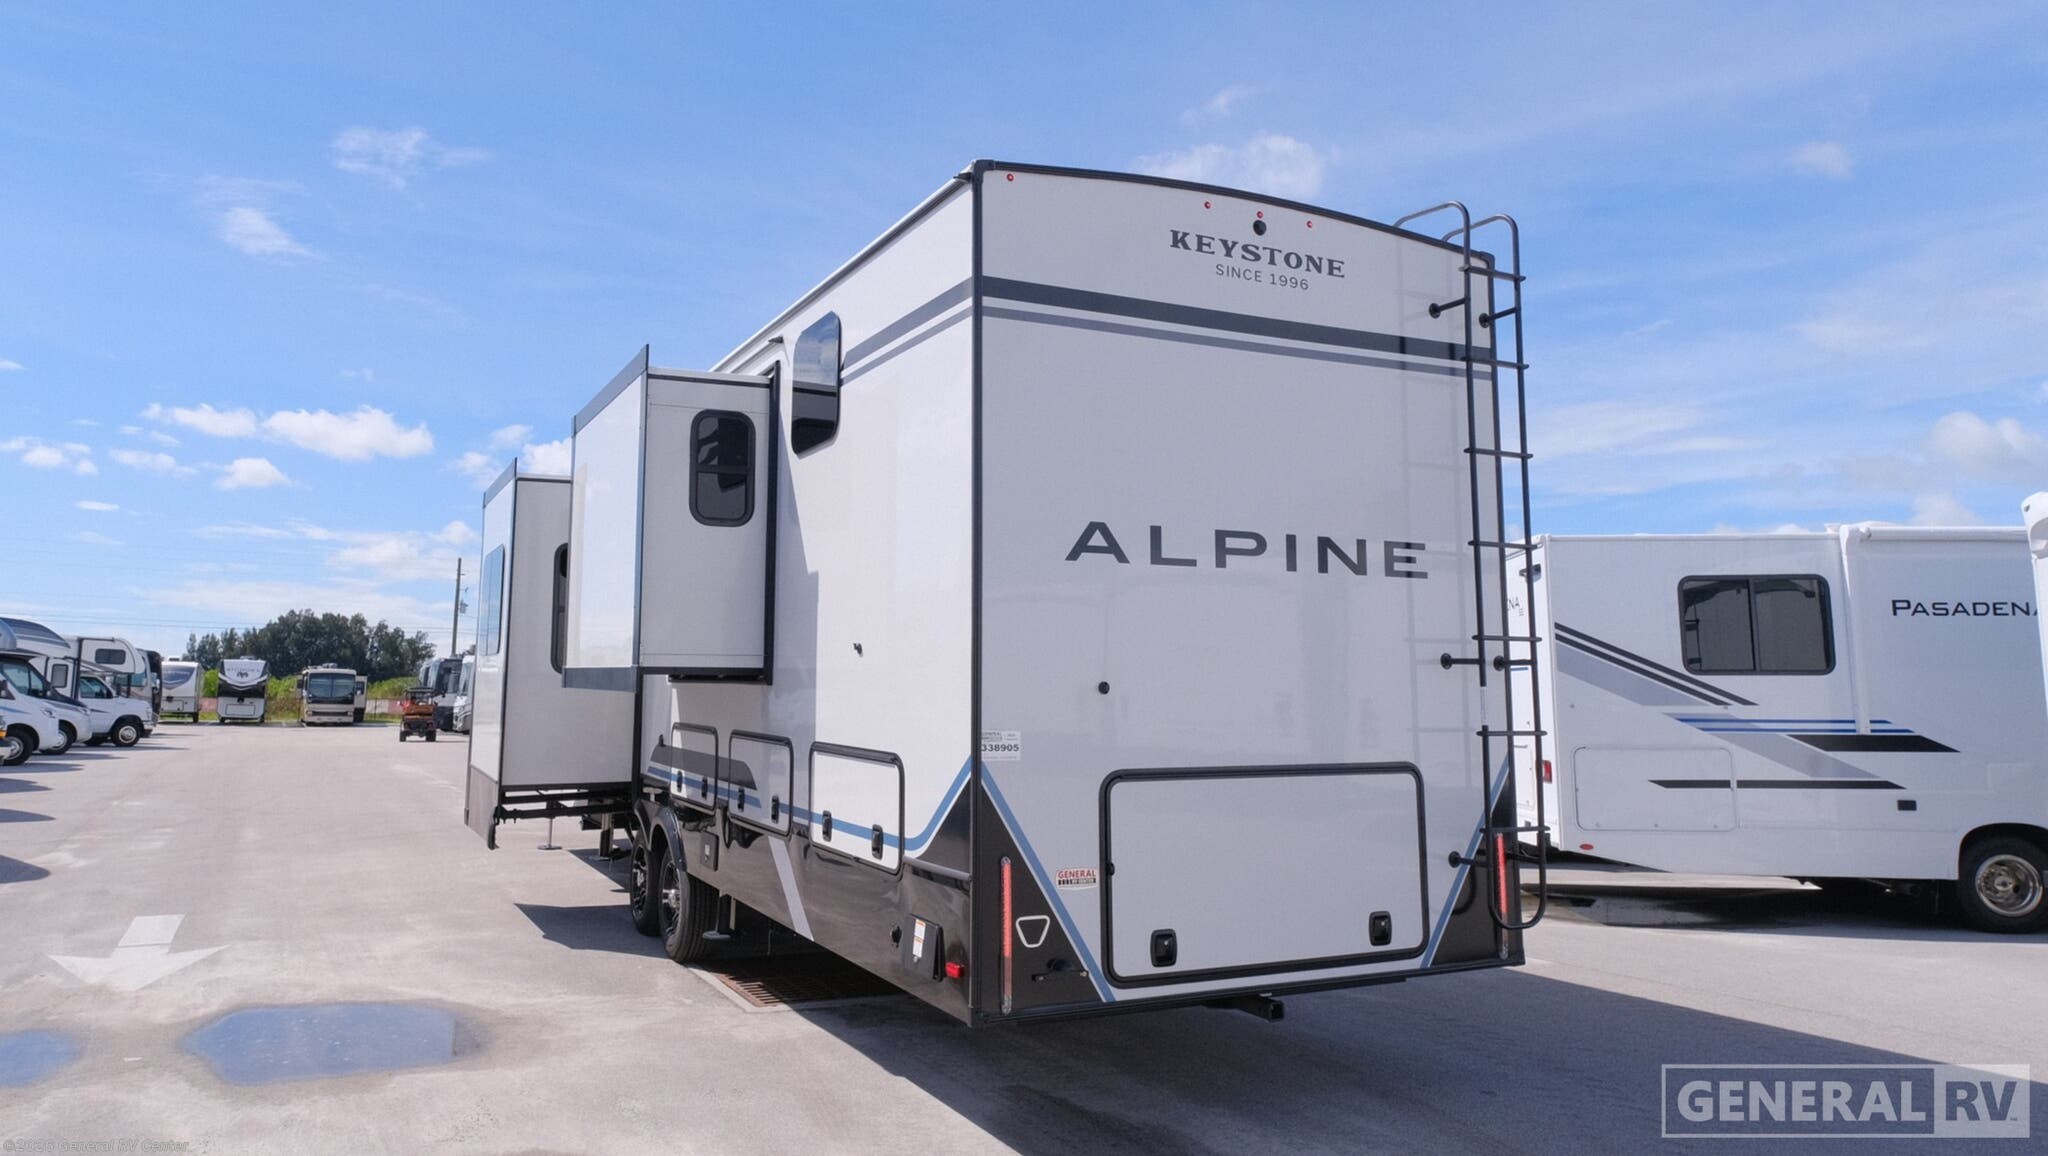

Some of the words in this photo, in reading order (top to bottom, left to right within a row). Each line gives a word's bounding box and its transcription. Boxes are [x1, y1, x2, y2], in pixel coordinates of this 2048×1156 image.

[1170, 229, 1345, 278] KEYSTONE
[1215, 263, 1263, 283] SINCE
[1269, 273, 1310, 290] 1996
[1065, 521, 1428, 579] ALPINE
[1891, 599, 2038, 617] PASADEN
[982, 743, 1020, 752] 338905
[1058, 870, 1096, 879] GENERAL
